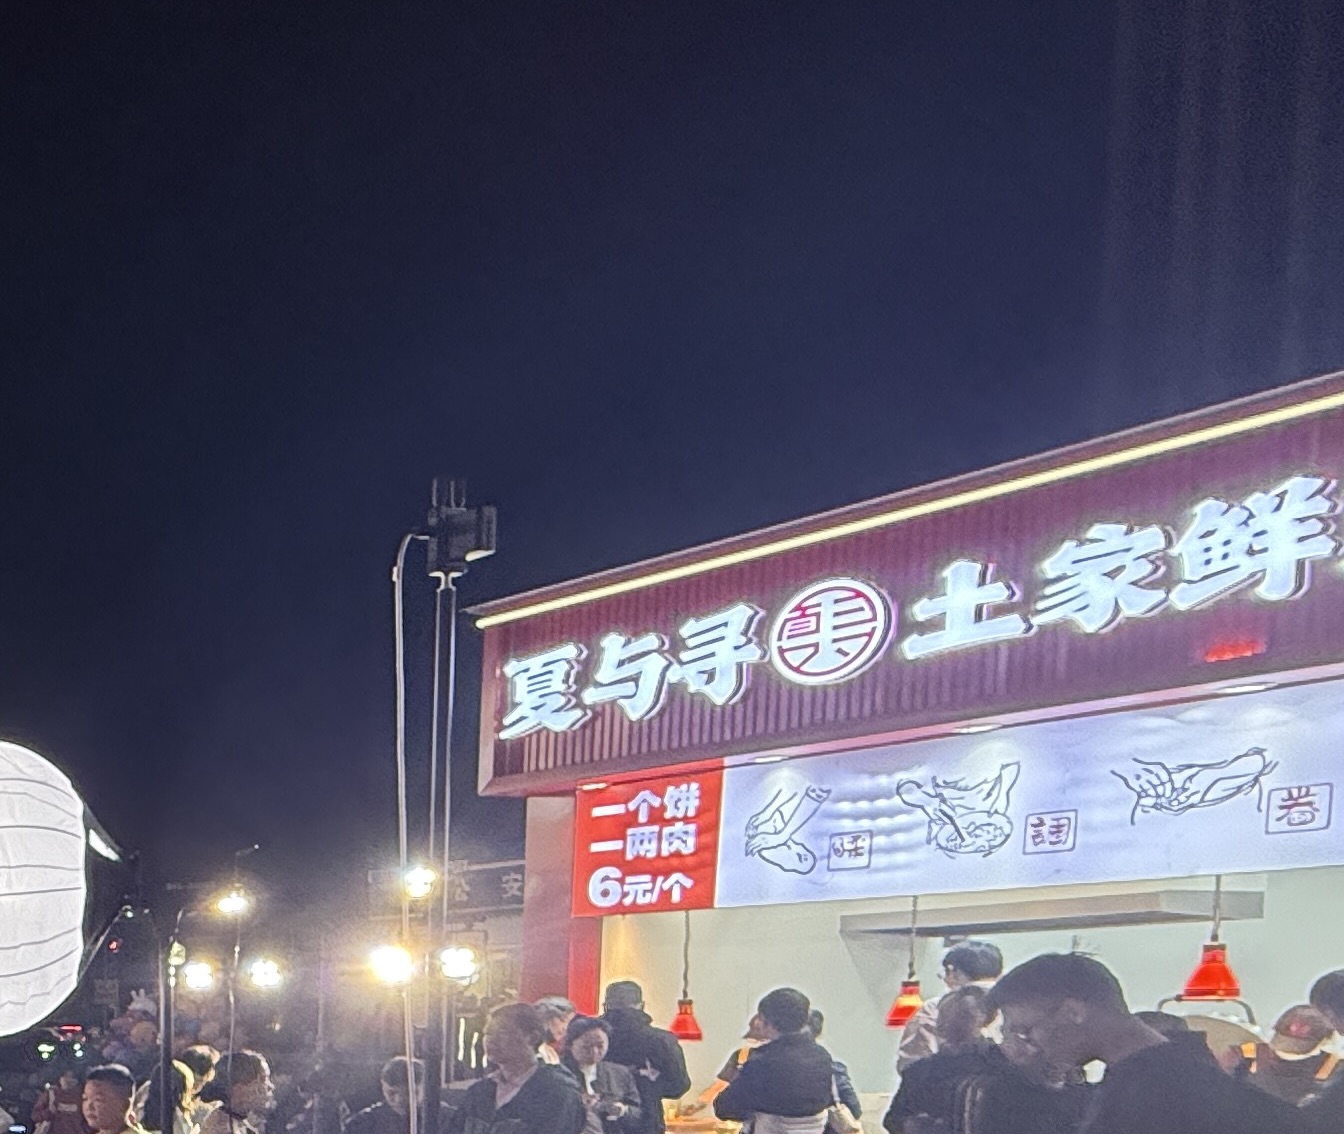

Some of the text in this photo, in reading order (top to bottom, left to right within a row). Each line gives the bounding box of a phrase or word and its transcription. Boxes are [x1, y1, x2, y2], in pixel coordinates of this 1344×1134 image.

[902, 475, 1340, 661] 土家鲜
[498, 603, 764, 741] 夏与寻
[591, 781, 701, 824] 一个饼
[589, 821, 698, 862] 一两肉
[588, 865, 695, 908] 6元/个
